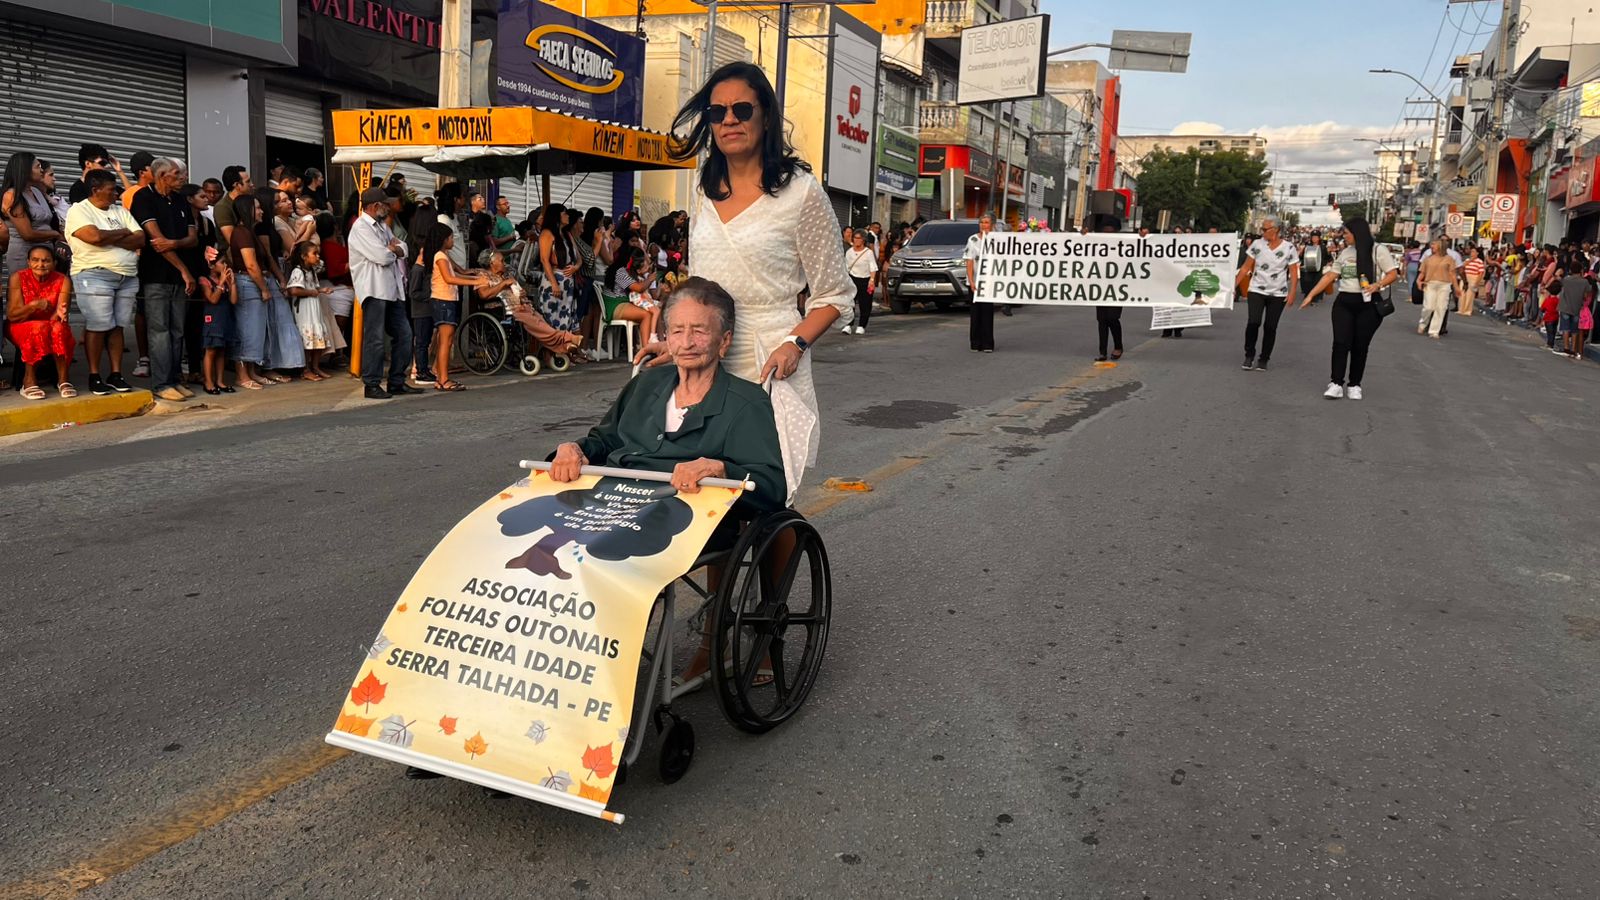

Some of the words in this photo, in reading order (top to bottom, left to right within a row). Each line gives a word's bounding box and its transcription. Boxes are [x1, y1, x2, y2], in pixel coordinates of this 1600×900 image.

[310, 0, 441, 49] VALENTI
[967, 22, 1036, 55] TELCOLOR
[540, 40, 570, 70] FAECA
[572, 46, 613, 80] SEGUROS
[497, 76, 517, 90] Desde
[518, 83, 531, 94] 1994
[532, 88, 559, 101] cuidando
[560, 94, 567, 103] do
[836, 114, 869, 144] Telcolor
[982, 237, 1057, 255] Mulheres
[1064, 238, 1230, 258] Serra-talhadenses
[980, 259, 1151, 279] EMPODERADAS
[977, 281, 986, 297] E
[993, 281, 1149, 301] PONDERADAS...
[594, 491, 604, 499] é
[614, 483, 655, 496] Nascer
[461, 577, 596, 620] ASSOCIAÇÃO
[420, 596, 501, 629] FOLHAS
[504, 614, 620, 659] OUTONAIS
[423, 625, 516, 665] TERCEIRA
[523, 649, 597, 685] IDADE
[386, 647, 450, 680] SERRA
[457, 664, 559, 709] TALHADA
[583, 698, 613, 723] PE
